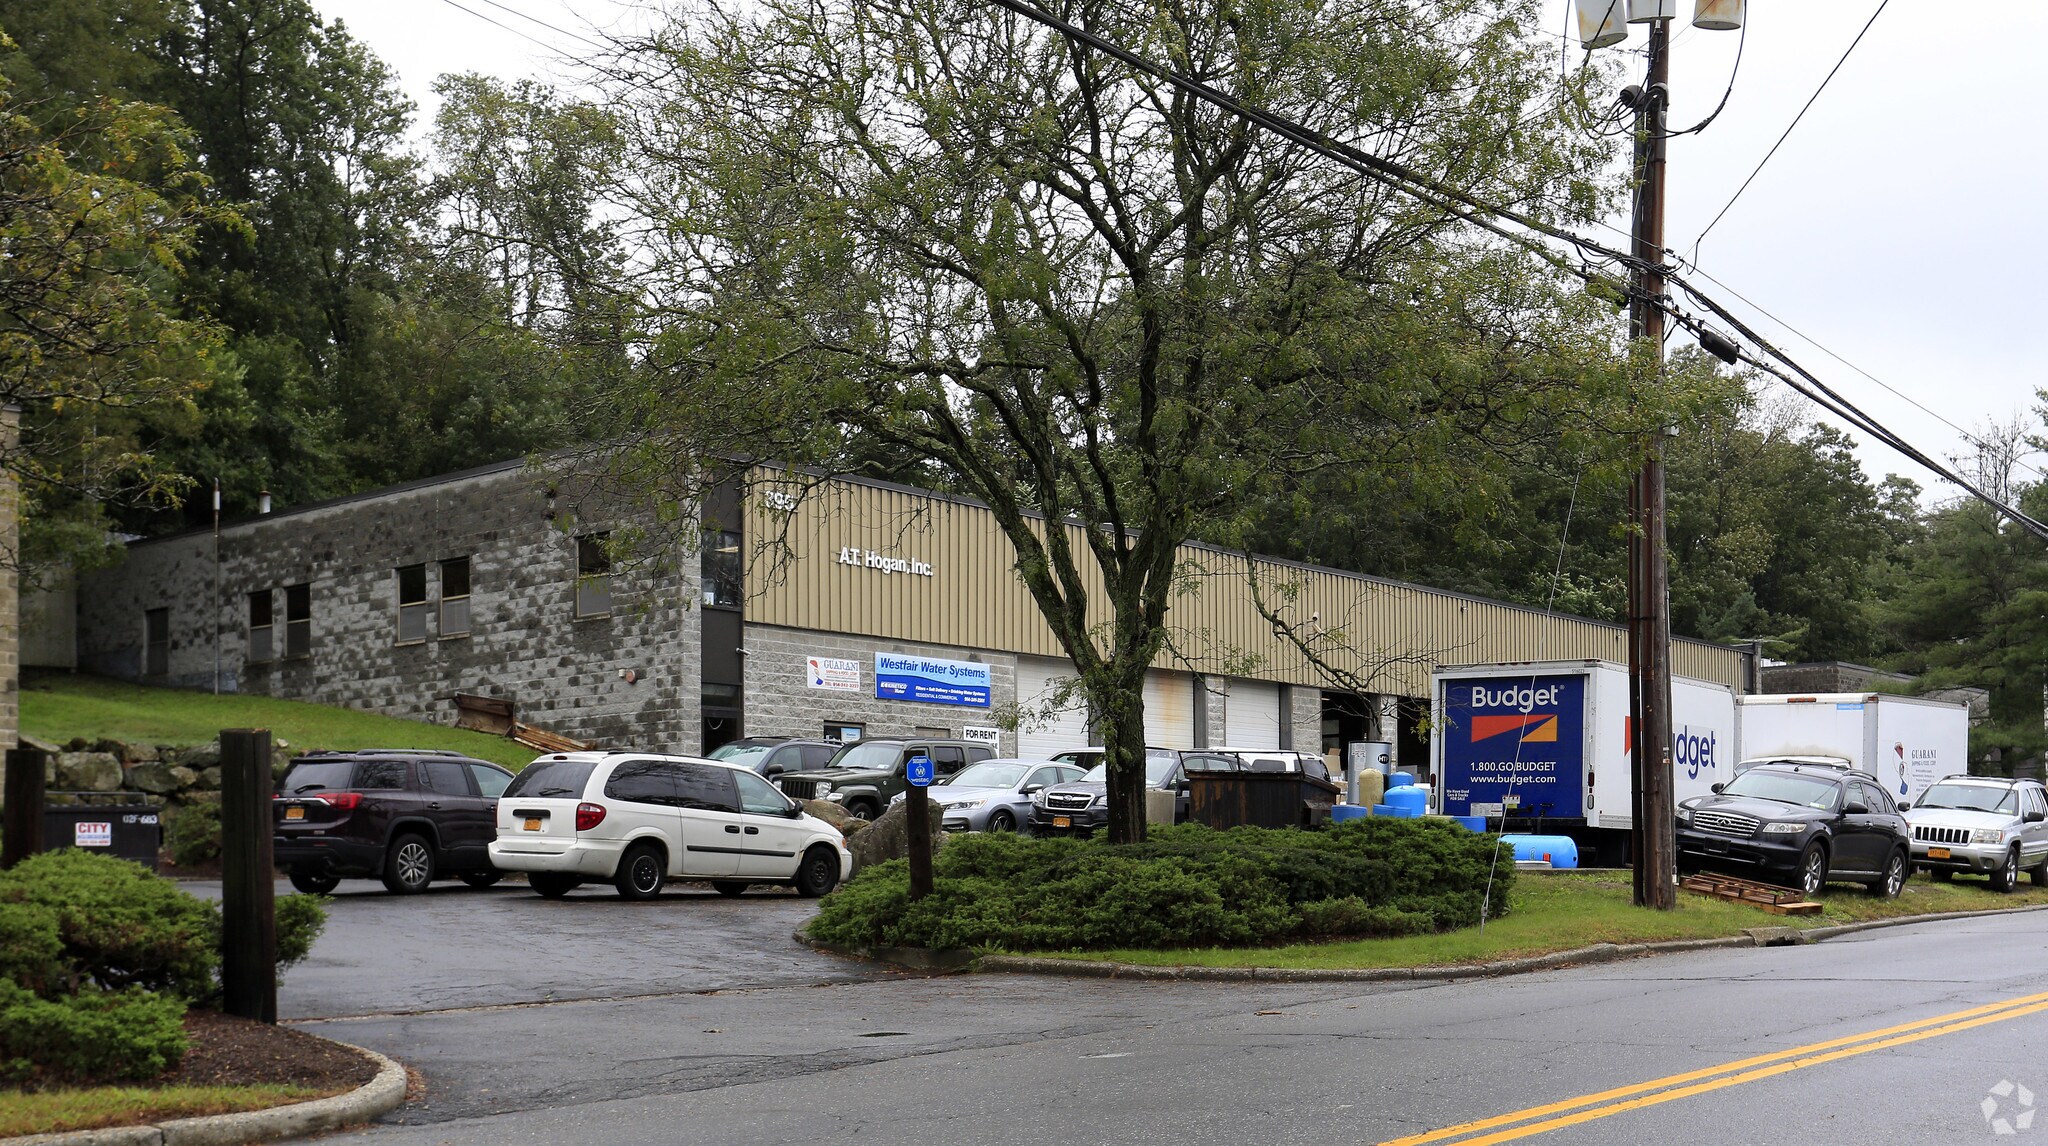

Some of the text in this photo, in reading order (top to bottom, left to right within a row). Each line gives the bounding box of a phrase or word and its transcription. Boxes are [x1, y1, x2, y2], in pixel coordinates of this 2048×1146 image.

[839, 547, 861, 566] A.T.
[823, 660, 859, 671] GUARANI
[880, 657, 986, 678] Westfair Water Systems
[1472, 684, 1559, 713] Budget
[966, 729, 997, 740] FOR RENT
[1672, 725, 1716, 780] dget
[1912, 750, 1937, 759] GUARANI
[1470, 762, 1556, 772] 1.800.GO.BUDGET
[1470, 774, 1556, 785] www.budget.com
[78, 823, 108, 833] CITY
